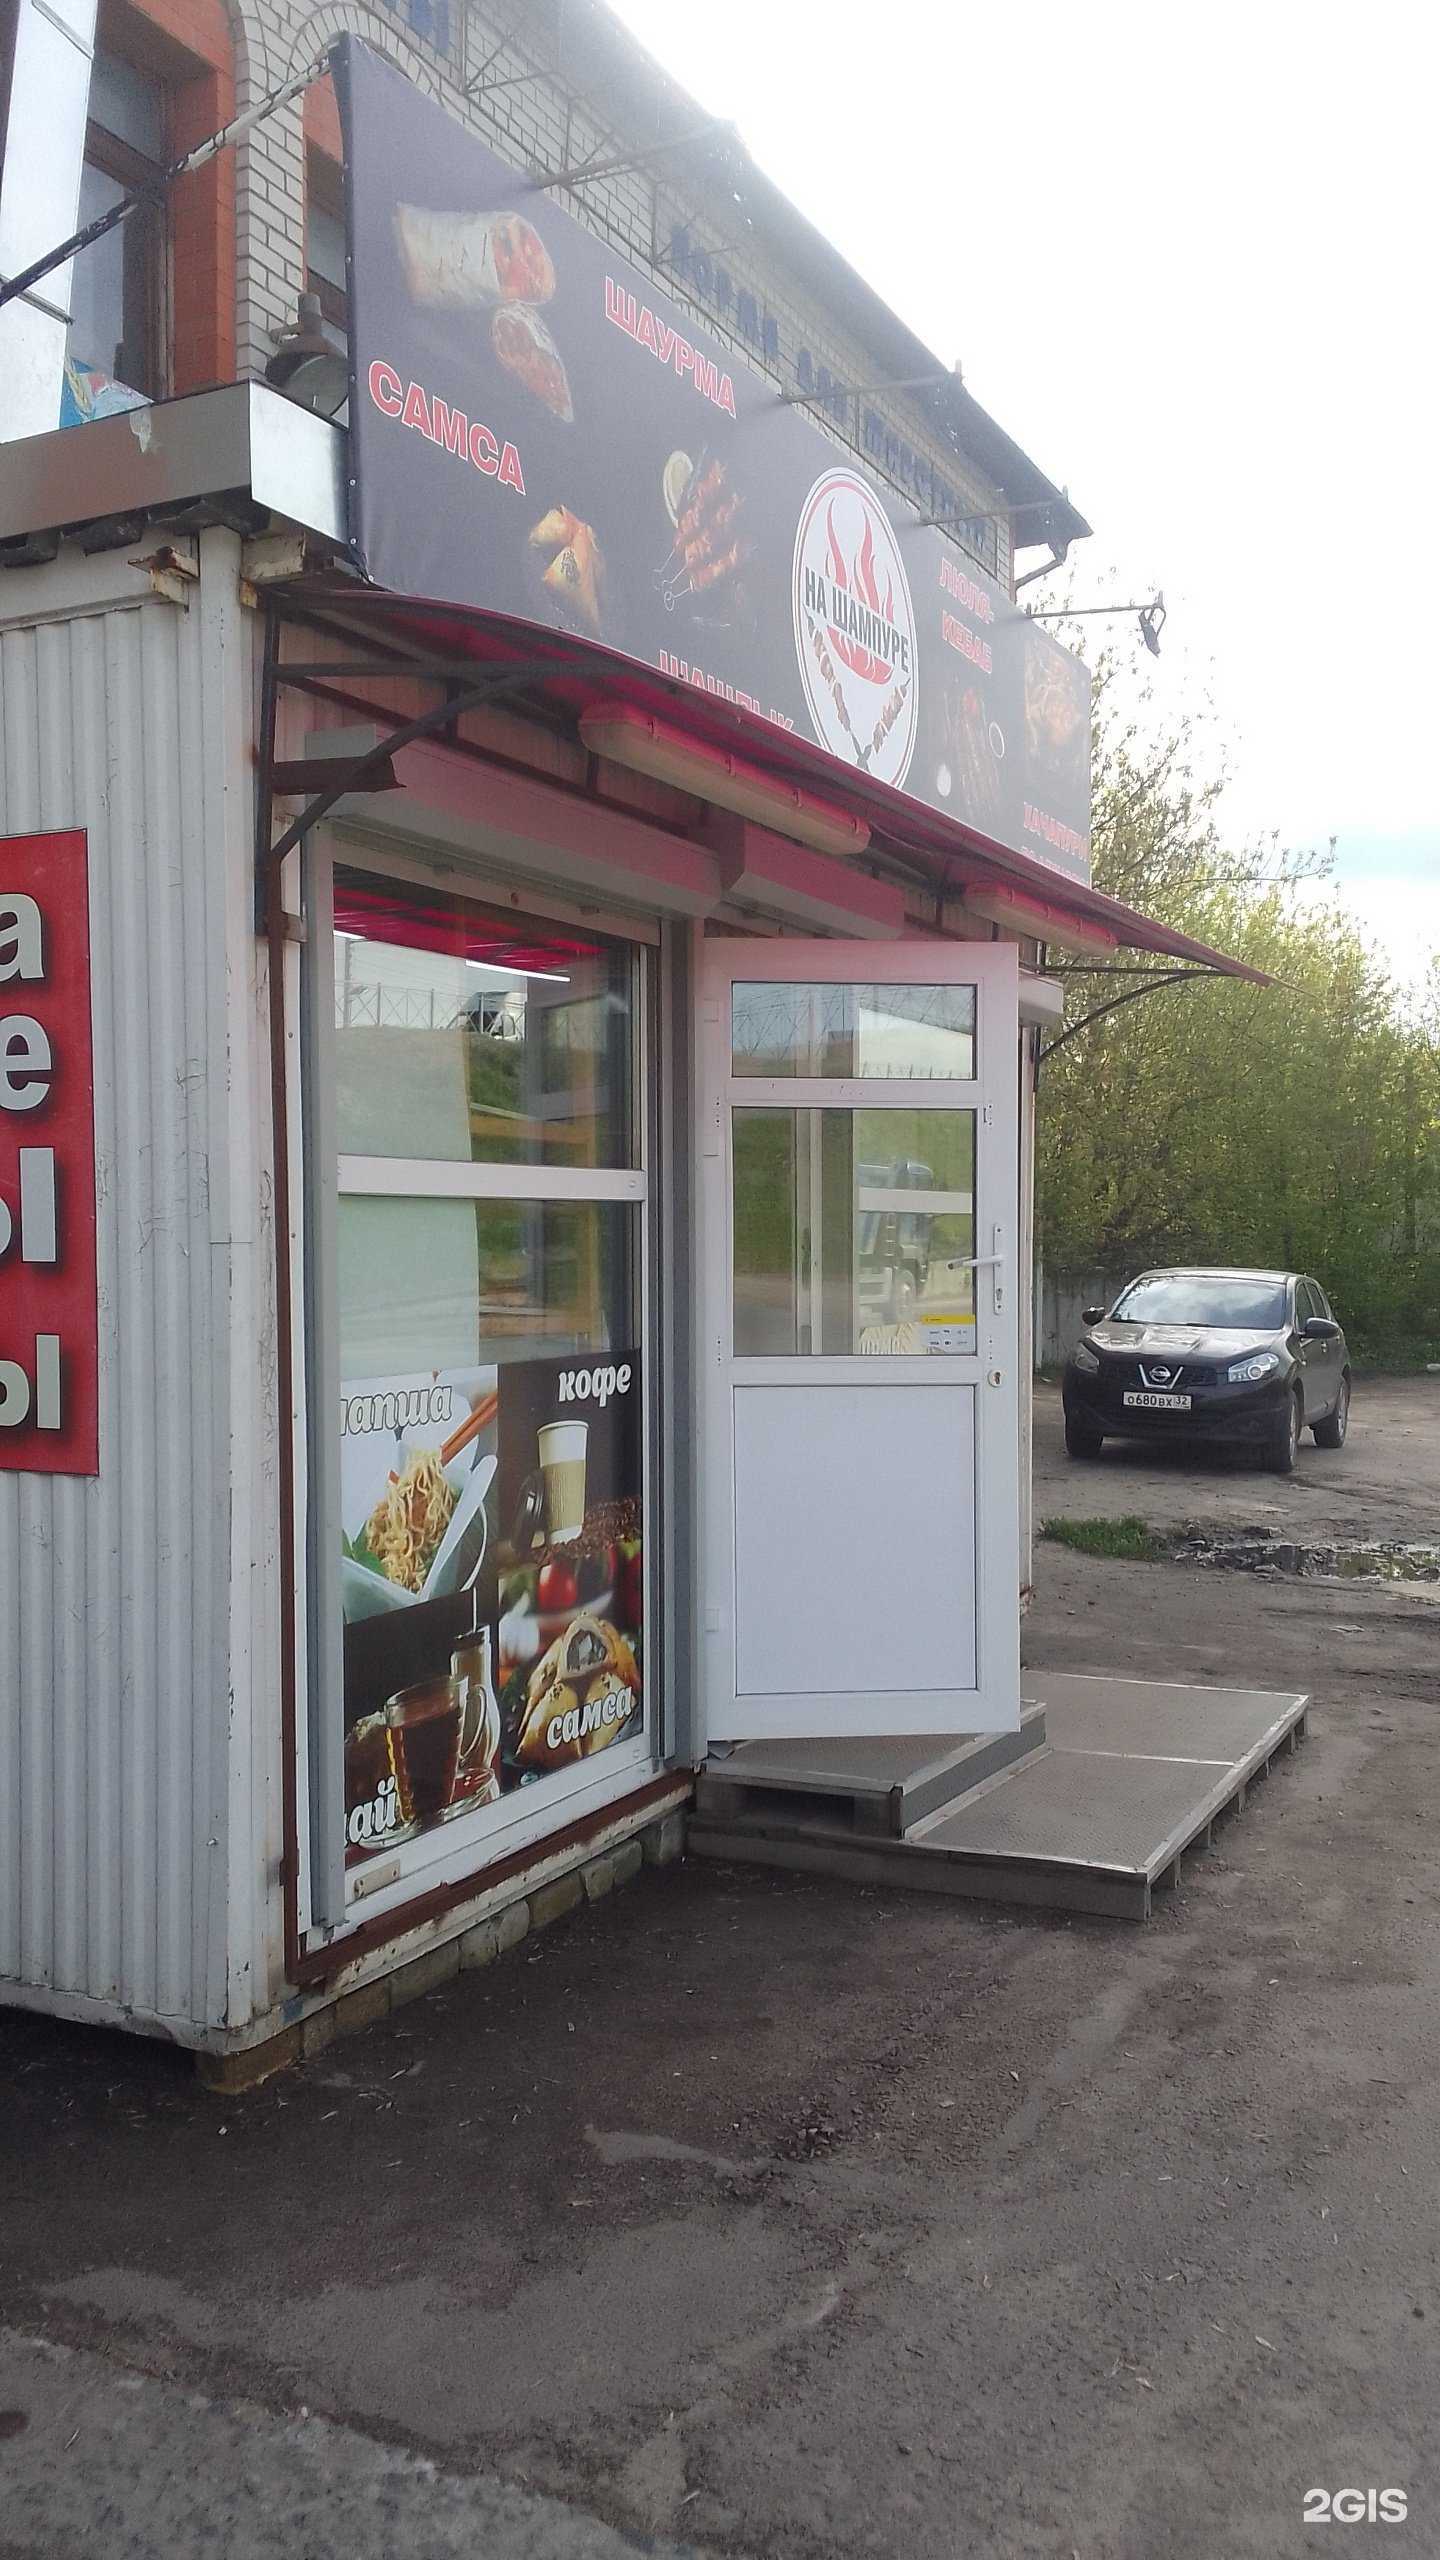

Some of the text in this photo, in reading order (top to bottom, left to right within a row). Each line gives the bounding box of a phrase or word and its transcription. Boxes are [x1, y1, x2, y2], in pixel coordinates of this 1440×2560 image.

[605, 275, 737, 420] ШАУРМА
[368, 360, 527, 496] САМСА
[805, 566, 910, 673] НА ШАМПУРЕ
[558, 1363, 632, 1408] кофе
[546, 1686, 633, 1749] самса
[344, 1775, 397, 1847] ай
